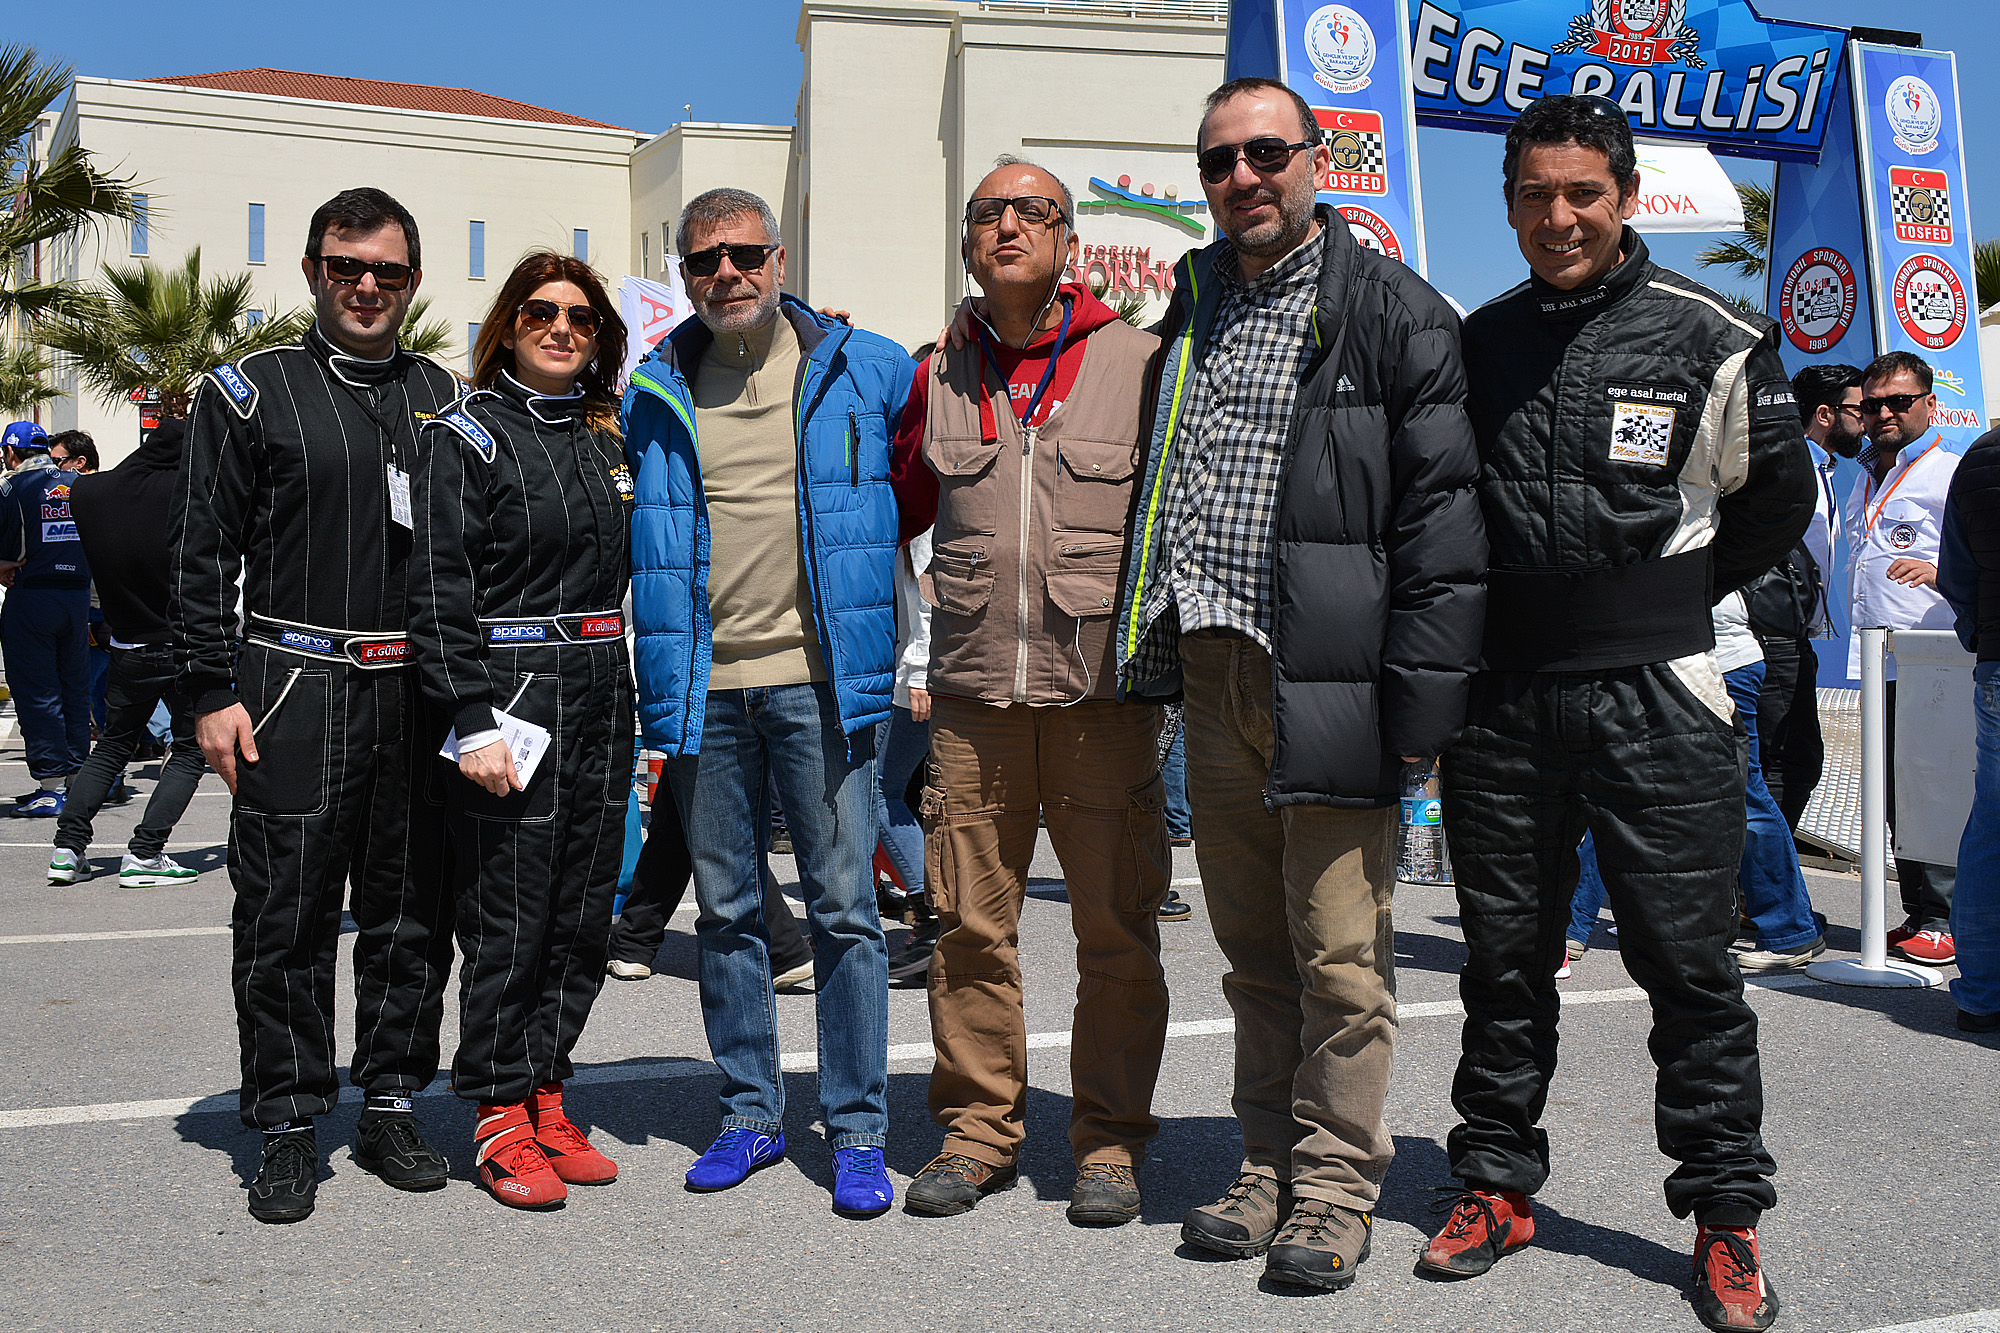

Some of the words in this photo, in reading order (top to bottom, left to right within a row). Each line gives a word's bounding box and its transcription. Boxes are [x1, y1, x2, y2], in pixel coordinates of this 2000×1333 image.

[1414, 2, 1550, 111] EGE
[1611, 43, 1652, 61] 2015
[1325, 173, 1381, 190] OSFED
[1634, 194, 1699, 215] NOVA
[1346, 209, 1391, 241] SPORLARI
[1899, 225, 1949, 241] TOSFED
[1085, 244, 1151, 260] FORUM
[1066, 258, 1178, 292] ORN
[1784, 315, 1796, 335] EGE
[1813, 250, 1849, 277] SPORLARI
[1897, 305, 1910, 324] EGE
[1922, 257, 1957, 286] SPORLARI
[1541, 303, 1557, 312] EGE
[1809, 337, 1828, 350] 1989
[1926, 336, 1945, 346] 1989
[217, 365, 248, 398] sparco
[1607, 387, 1628, 398] ege
[1630, 387, 1654, 399] asal
[1655, 391, 1687, 403] metal
[1618, 405, 1632, 414] Ege
[449, 413, 488, 447] sparco
[493, 626, 544, 638] sparco
[284, 632, 331, 648] sparco
[367, 643, 413, 658] B.GÜNGÖ
[502, 1181, 531, 1194] sparco
